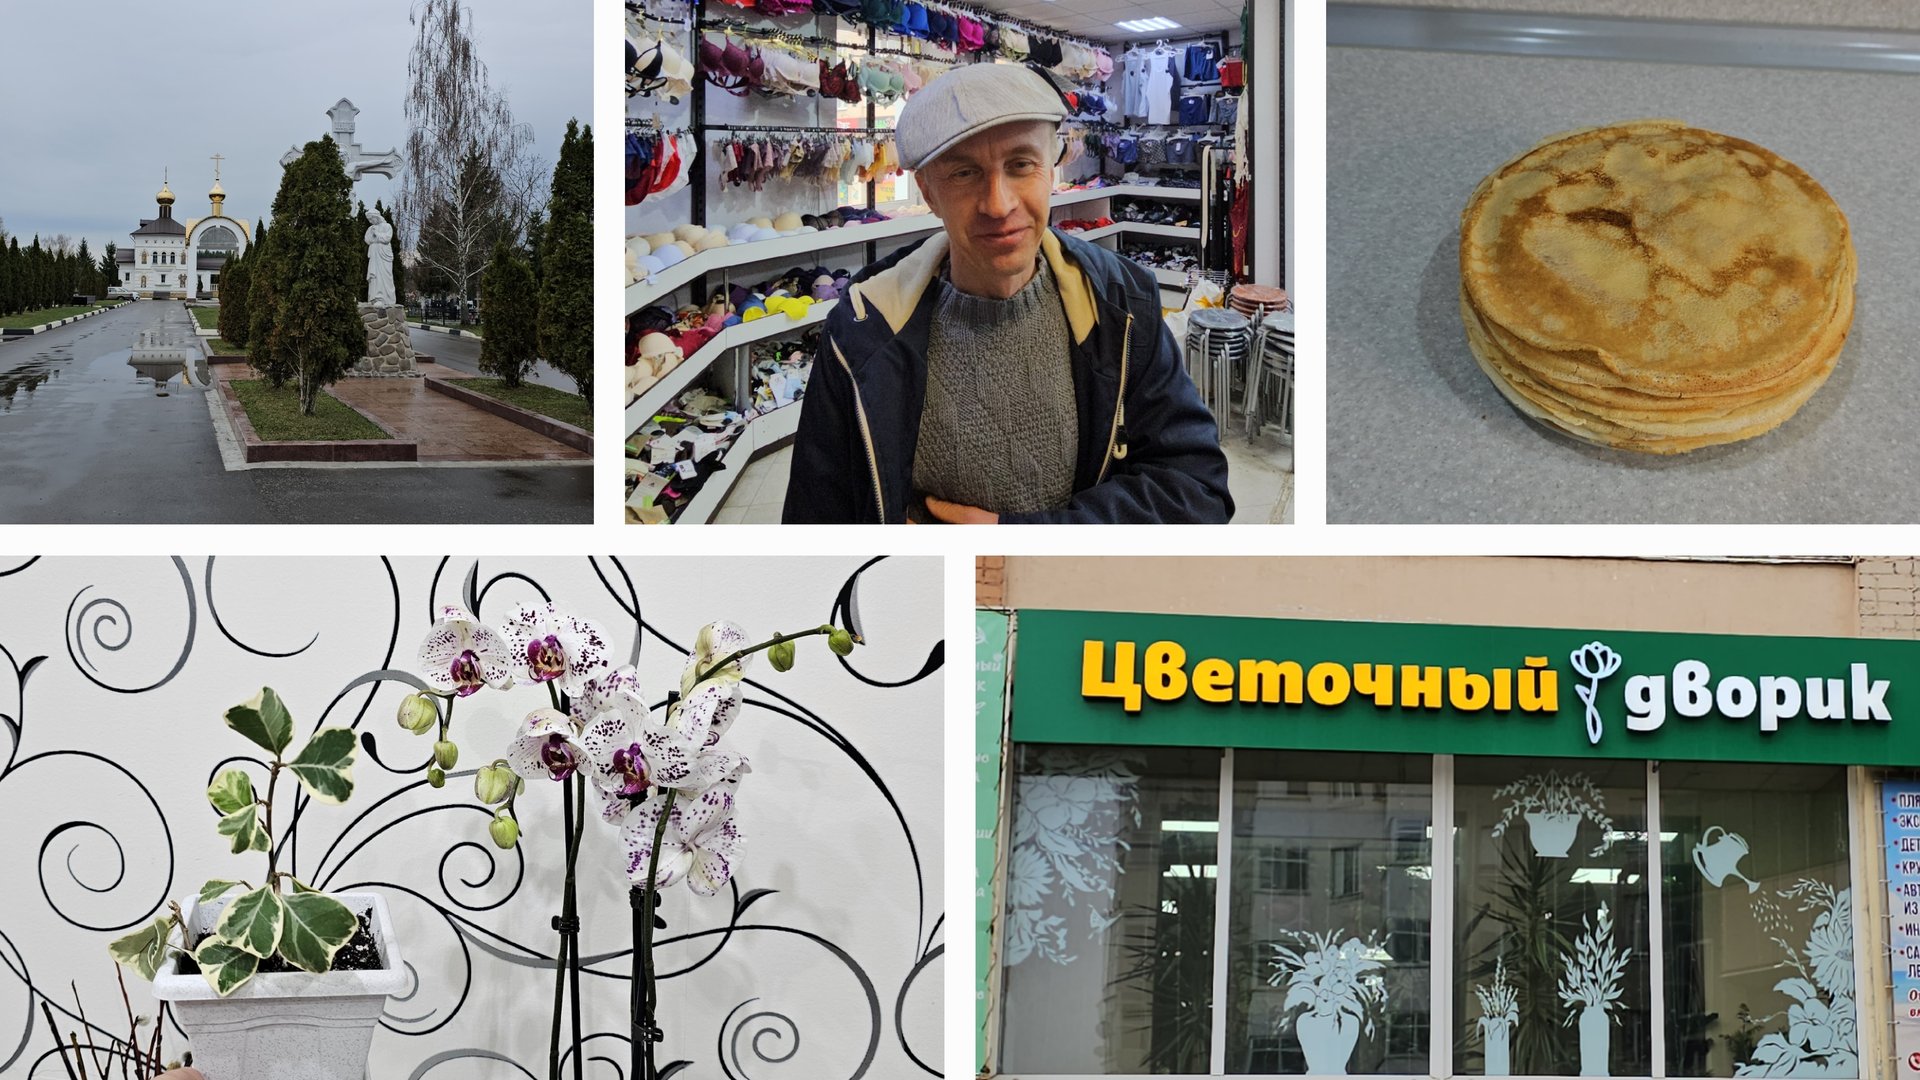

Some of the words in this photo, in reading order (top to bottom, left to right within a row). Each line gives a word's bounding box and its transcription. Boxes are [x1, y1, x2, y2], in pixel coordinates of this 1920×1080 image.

[1082, 640, 1558, 712] Цветочный
[1624, 659, 1893, 731] дворик
[1904, 901, 1918, 915] ИЗ
